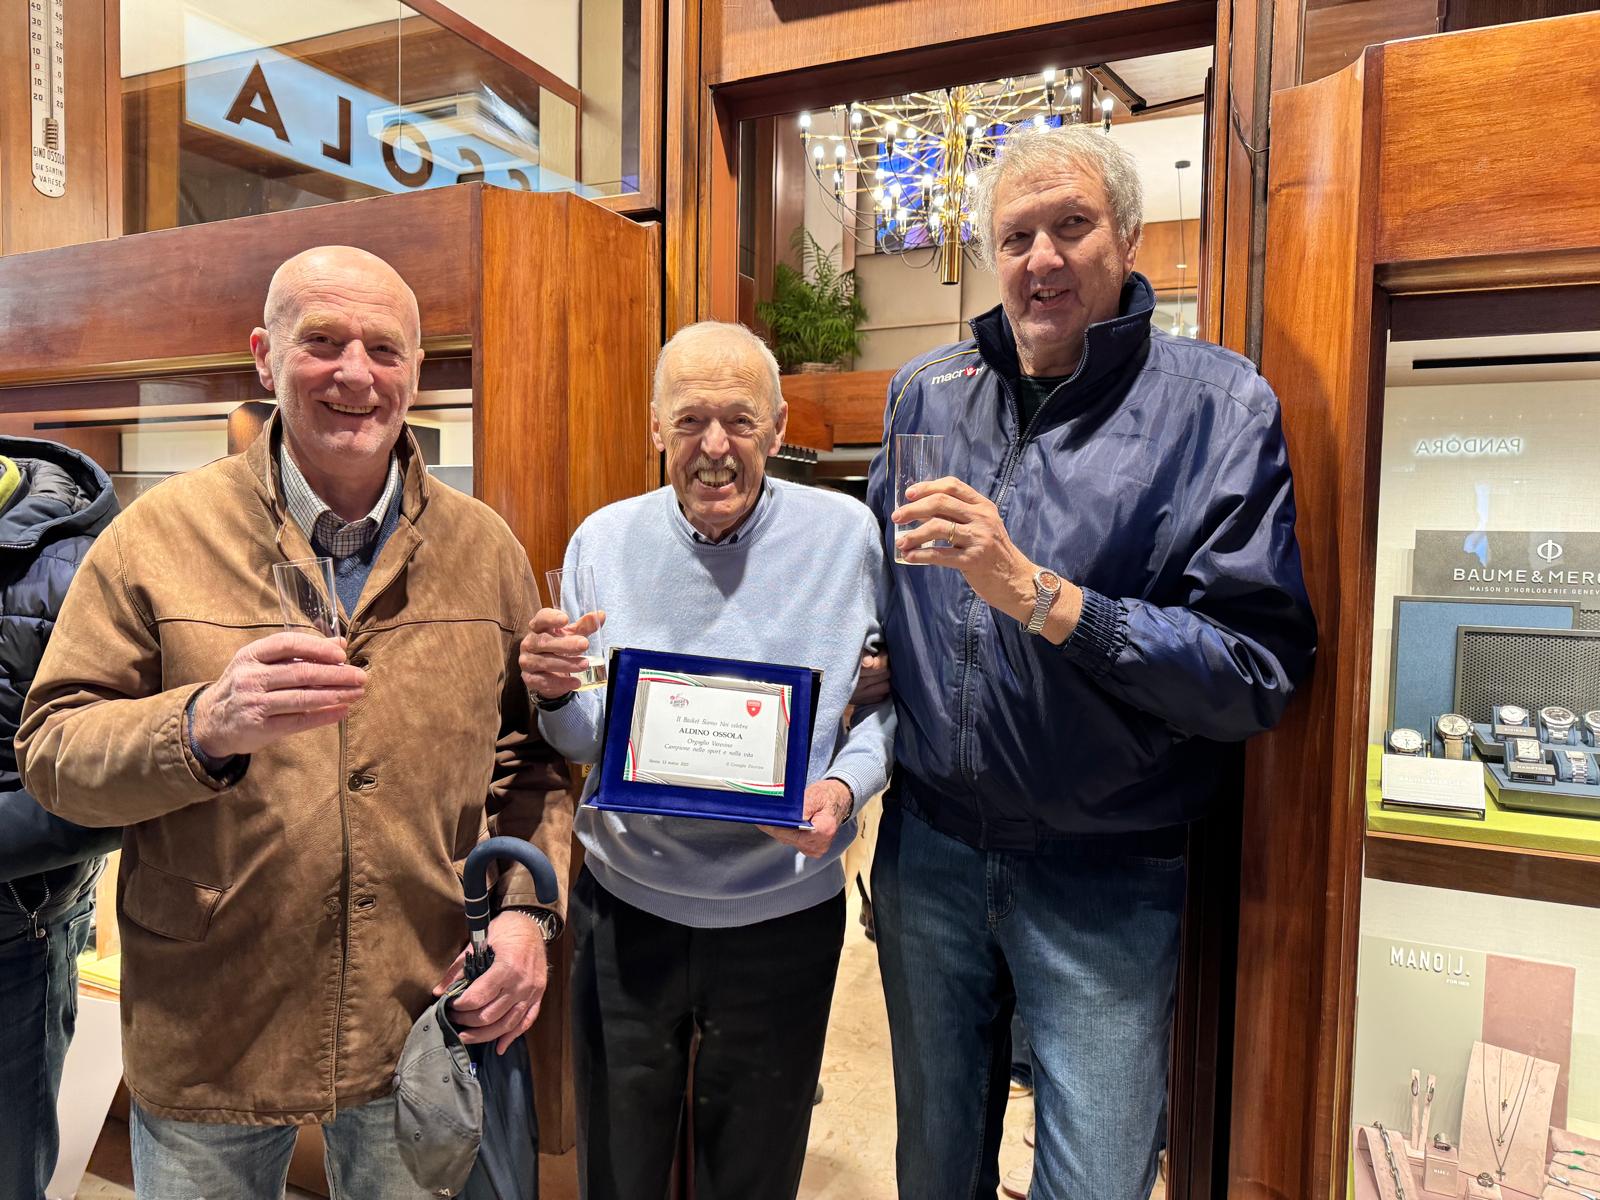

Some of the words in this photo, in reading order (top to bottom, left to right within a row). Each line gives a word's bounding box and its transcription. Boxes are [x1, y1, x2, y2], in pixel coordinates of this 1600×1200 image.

[31, 2, 41, 11] 40
[32, 17, 41, 26] 30
[32, 32, 41, 40] 20
[34, 77, 42, 86] 10
[1453, 568, 1527, 583] BAUME
[1548, 570, 1600, 586] MER
[1469, 585, 1501, 593] MAISON
[1504, 586, 1568, 595] D'HORLOGERIE
[679, 727, 710, 737] ALDINO
[712, 730, 743, 740] OSSOLA
